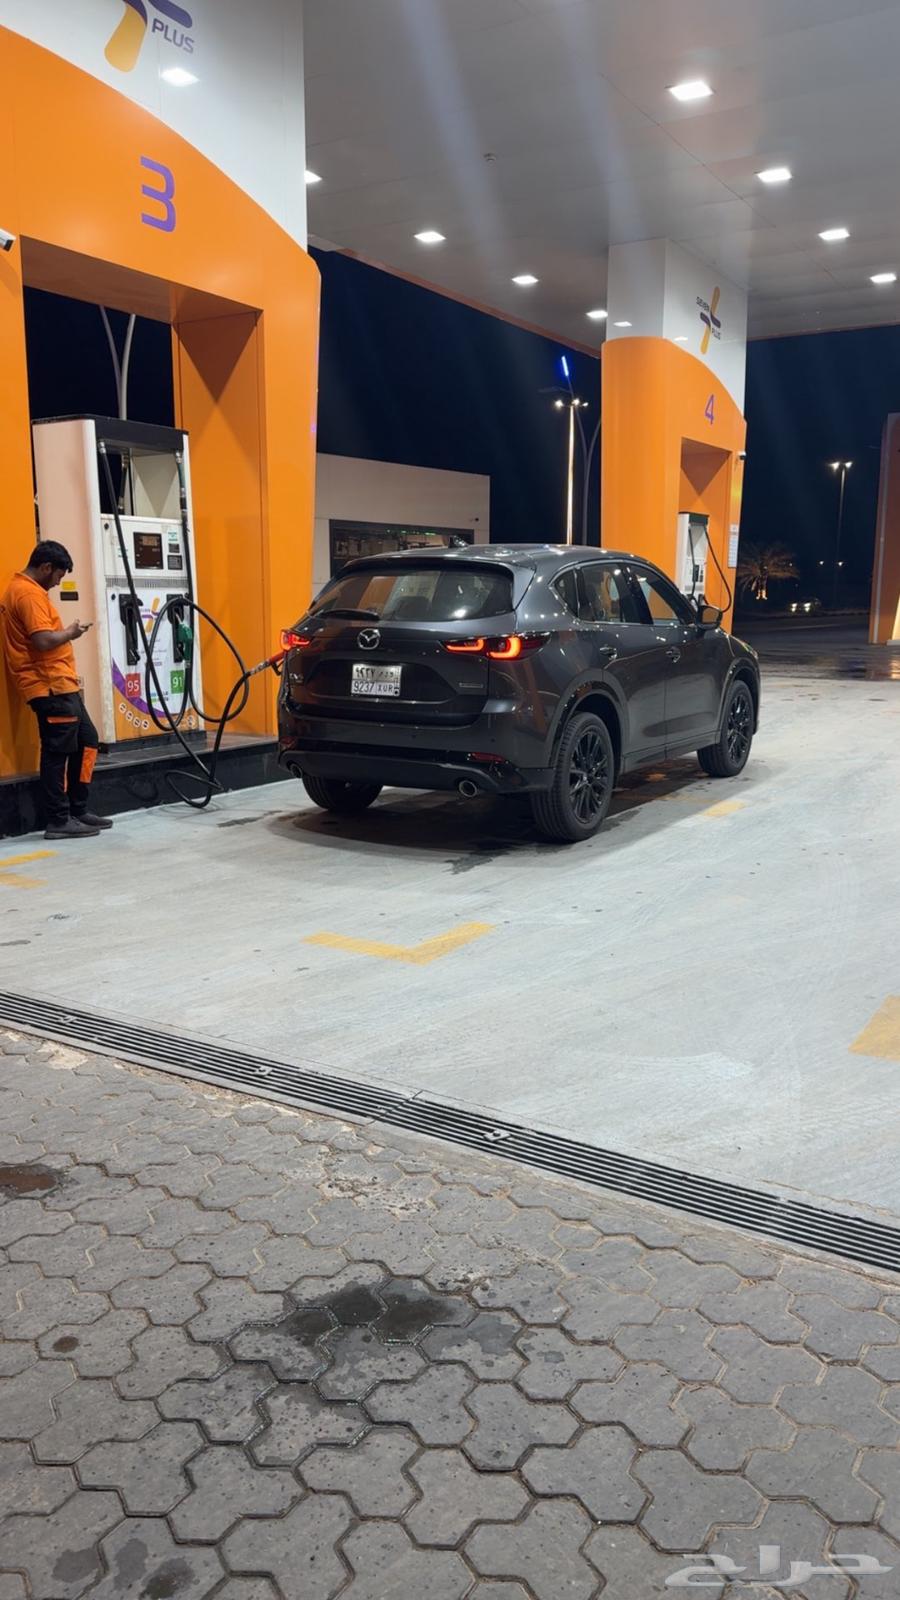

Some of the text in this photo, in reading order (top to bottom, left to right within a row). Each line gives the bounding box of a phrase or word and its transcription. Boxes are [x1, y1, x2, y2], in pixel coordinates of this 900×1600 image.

[152, 18, 195, 54] PLUS
[140, 156, 177, 233] 3
[704, 394, 716, 425] 4
[127, 680, 140, 692] 95
[172, 677, 183, 688] 91
[353, 681, 375, 693] 9237
